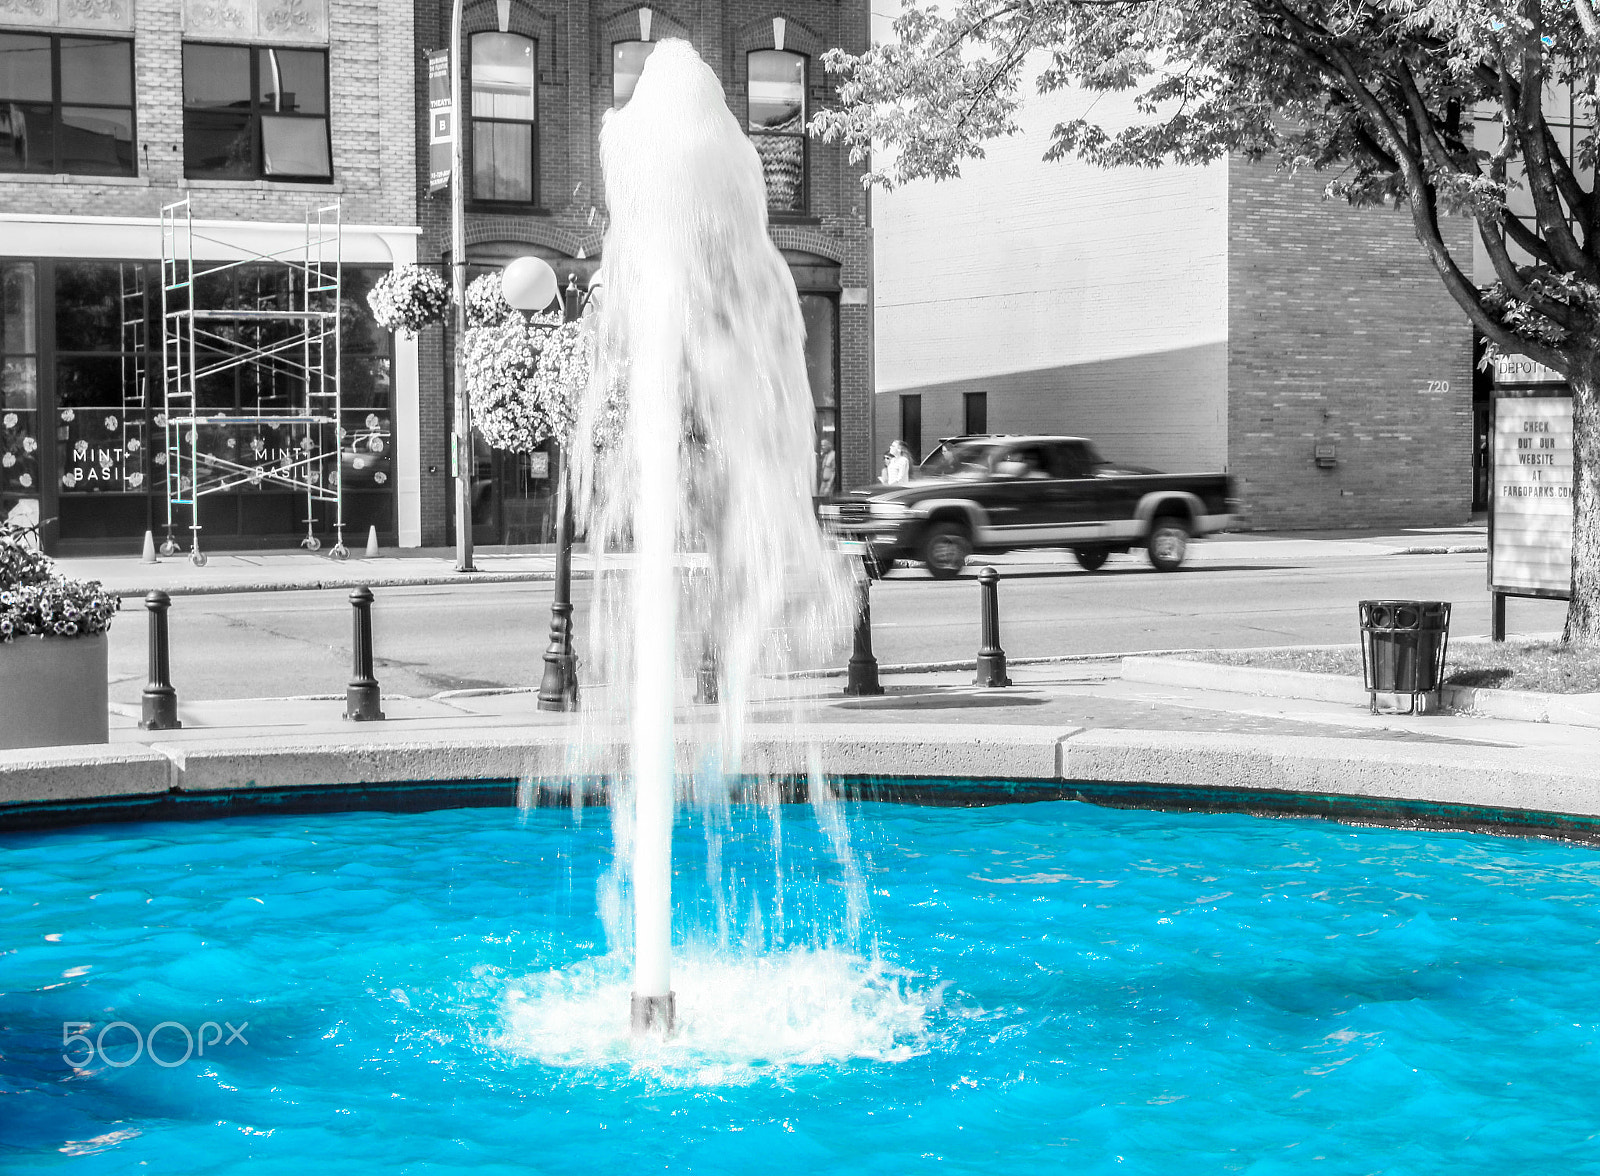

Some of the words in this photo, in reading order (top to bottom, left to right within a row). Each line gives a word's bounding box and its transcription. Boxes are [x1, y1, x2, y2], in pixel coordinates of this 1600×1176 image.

[439, 120, 446, 131] B
[1499, 362, 1537, 374] DEPOT
[1427, 380, 1449, 393] 720
[1523, 421, 1549, 433] CHECK
[1518, 437, 1533, 449] OUT
[1539, 437, 1555, 449] OUR
[1518, 453, 1554, 465] WEBSITE
[74, 467, 131, 481] BASIL
[255, 465, 309, 479] BASIL
[1532, 470, 1542, 481] AT
